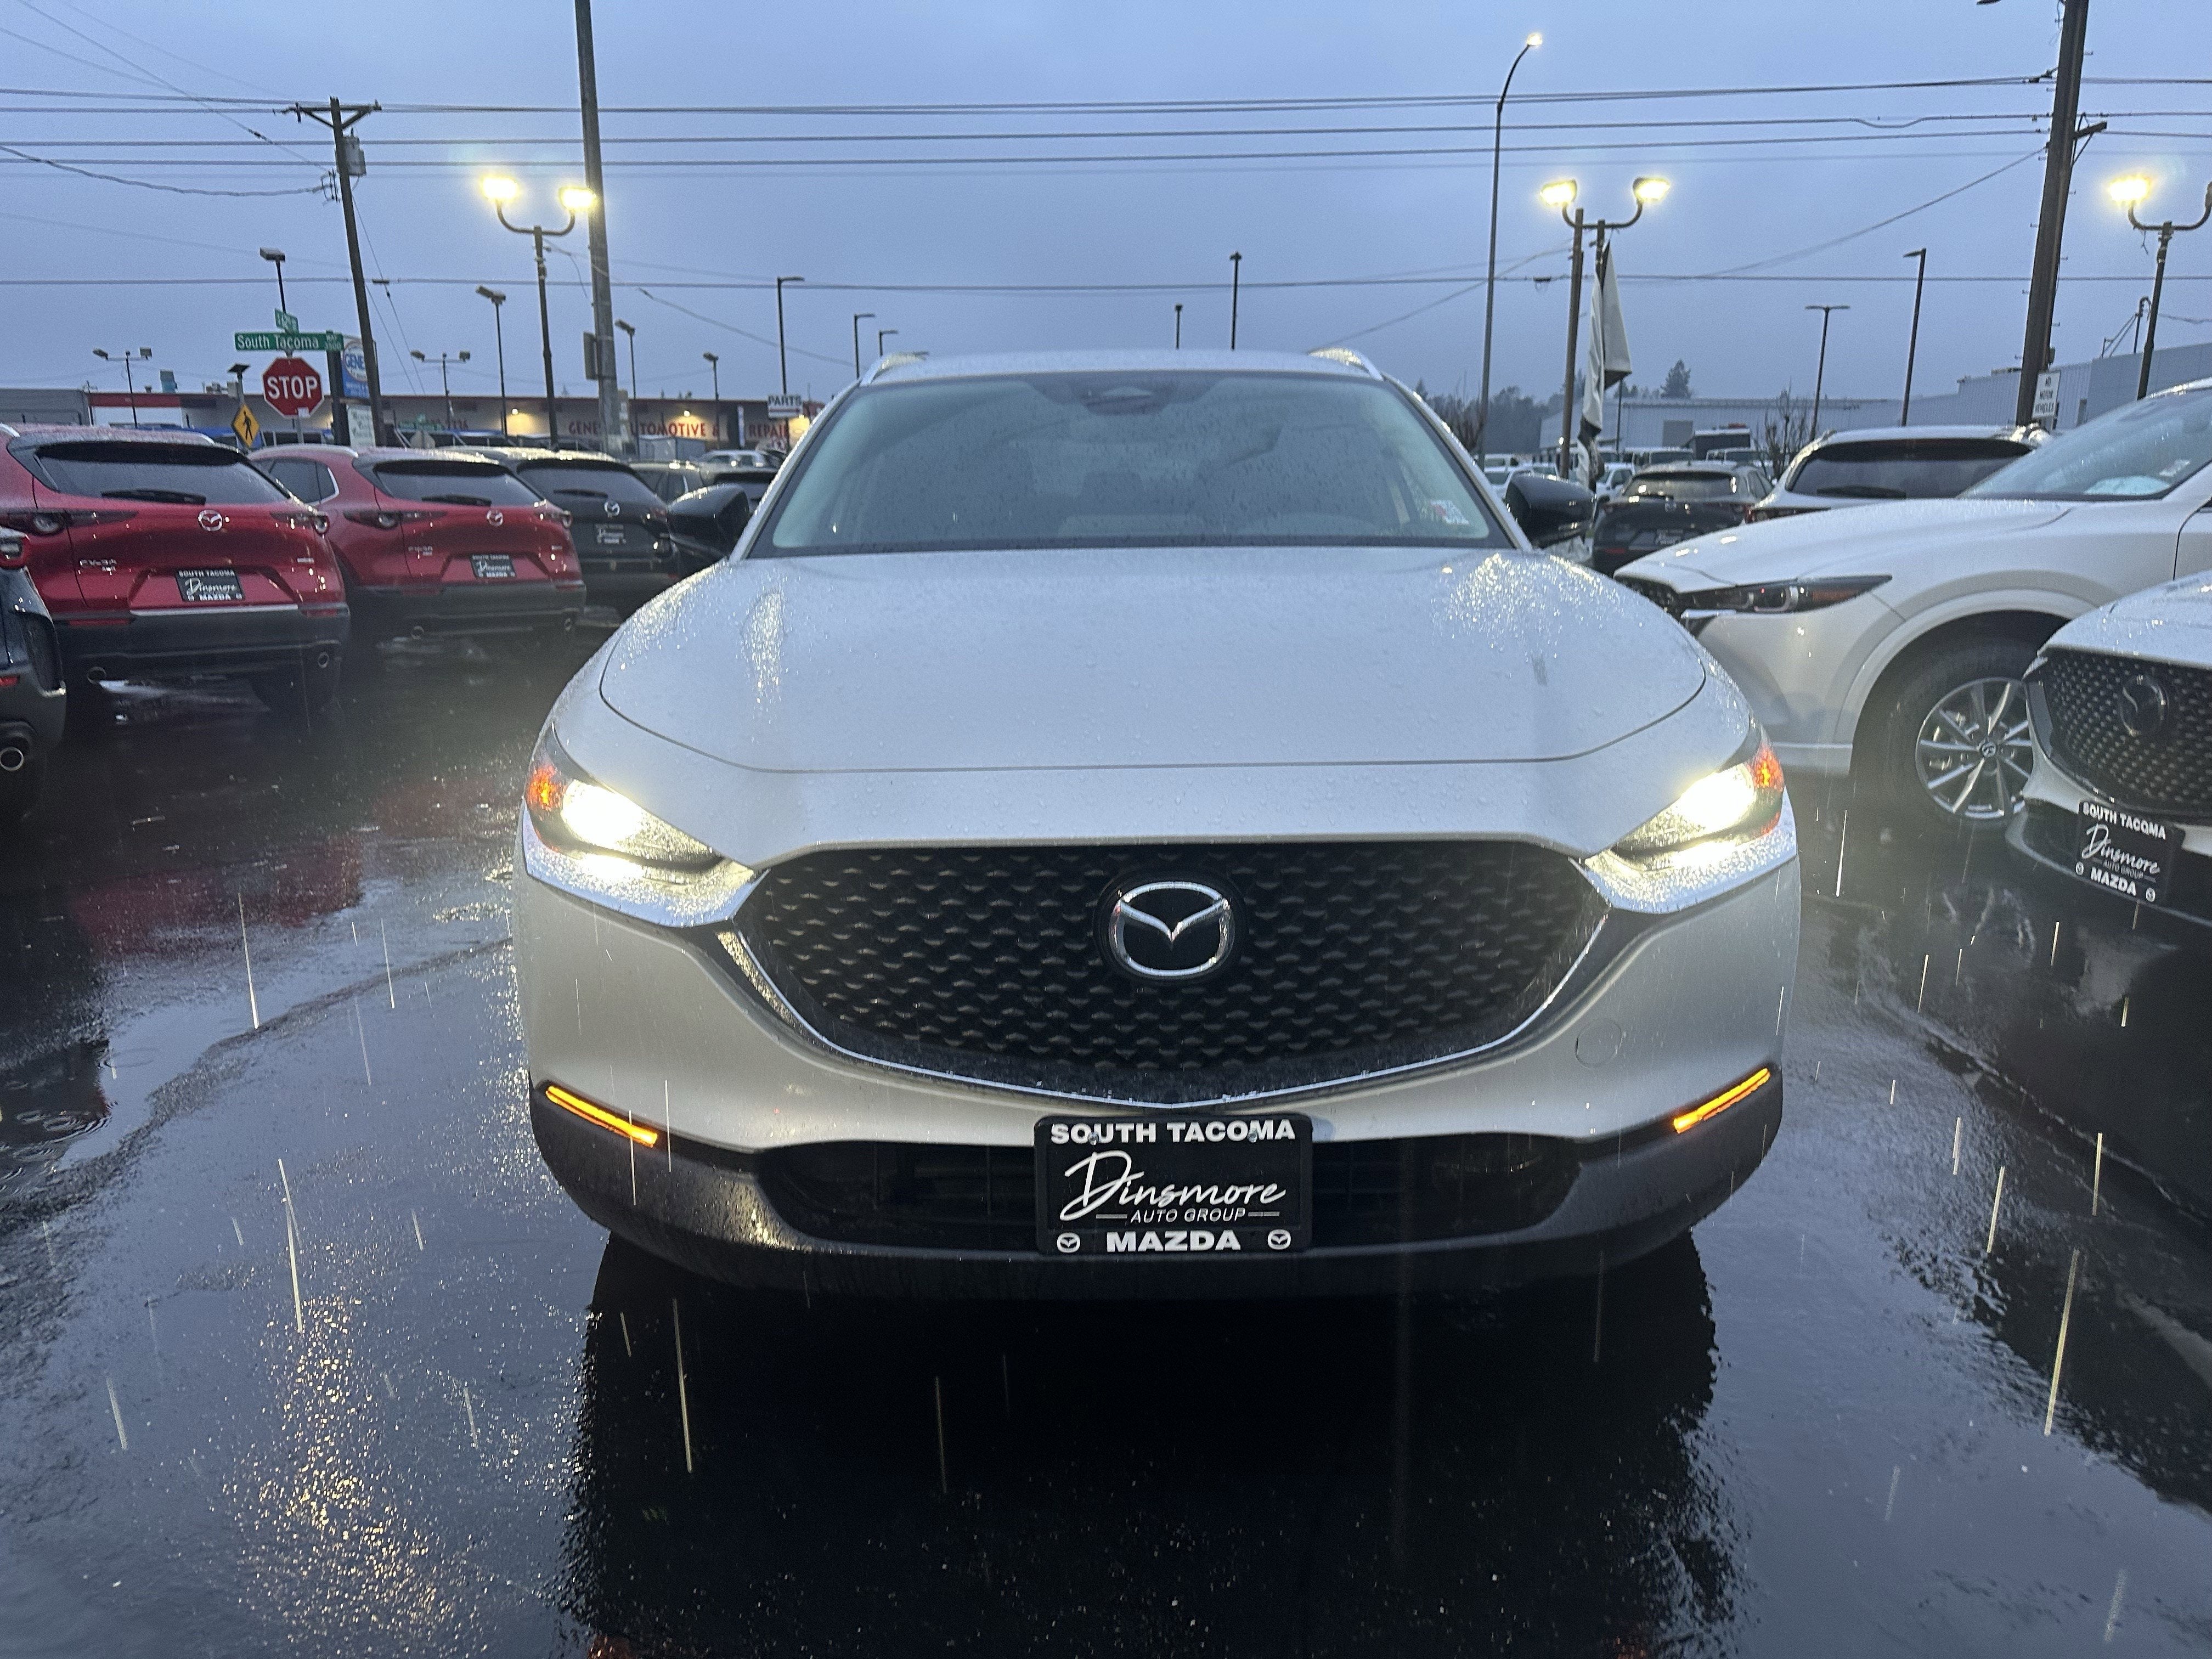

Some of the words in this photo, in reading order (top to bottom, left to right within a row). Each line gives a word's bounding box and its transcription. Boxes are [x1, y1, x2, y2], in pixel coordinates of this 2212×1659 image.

[238, 334, 270, 349] South
[275, 335, 319, 349] Tacoma
[267, 375, 318, 399] STOP
[768, 394, 802, 407] PARTS
[631, 422, 706, 437] UTOMOTIVE
[2083, 802, 2117, 825] SOUTH
[2119, 812, 2166, 840] TACOMA
[2081, 823, 2160, 874] Dinsmore
[2090, 866, 2136, 896] MAZDA
[1051, 1122, 1156, 1144] SOUTH
[1166, 1119, 1295, 1143] TACOMA
[1059, 1149, 1286, 1222] Dinsmore
[1130, 1209, 1178, 1223] AUTO
[1184, 1207, 1246, 1222] GROUP
[1107, 1230, 1242, 1252] MAZDA
